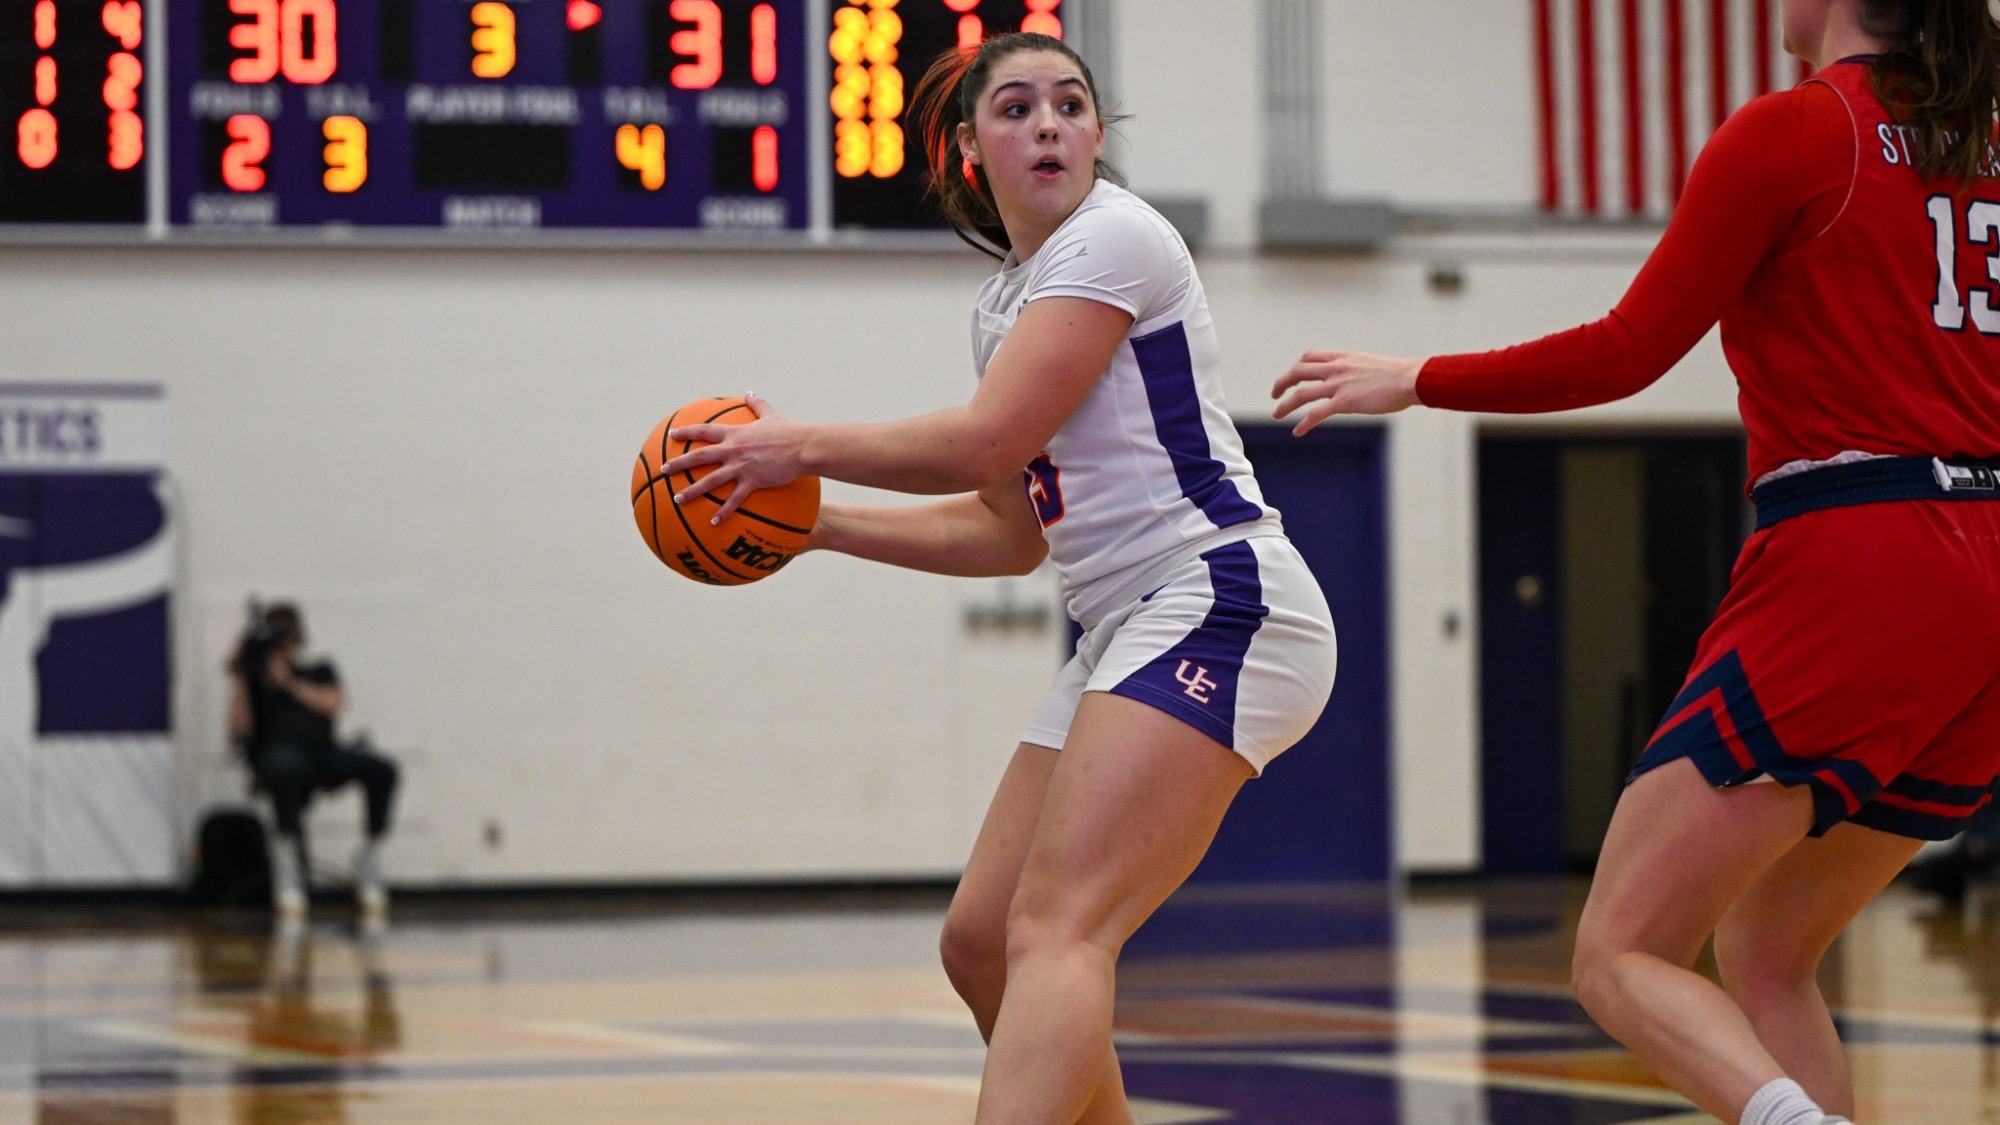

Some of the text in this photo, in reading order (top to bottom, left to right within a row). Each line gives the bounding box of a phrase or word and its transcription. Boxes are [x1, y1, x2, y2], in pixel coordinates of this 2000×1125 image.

[229, 0, 337, 84] 30
[471, 2, 516, 78] 3
[18, 108, 57, 169] 0
[222, 114, 270, 192] 2
[323, 115, 367, 193] 3
[616, 123, 665, 191] 4
[1926, 193, 2000, 336] 13
[0, 408, 100, 455] TICS
[1174, 658, 1218, 704] UE
